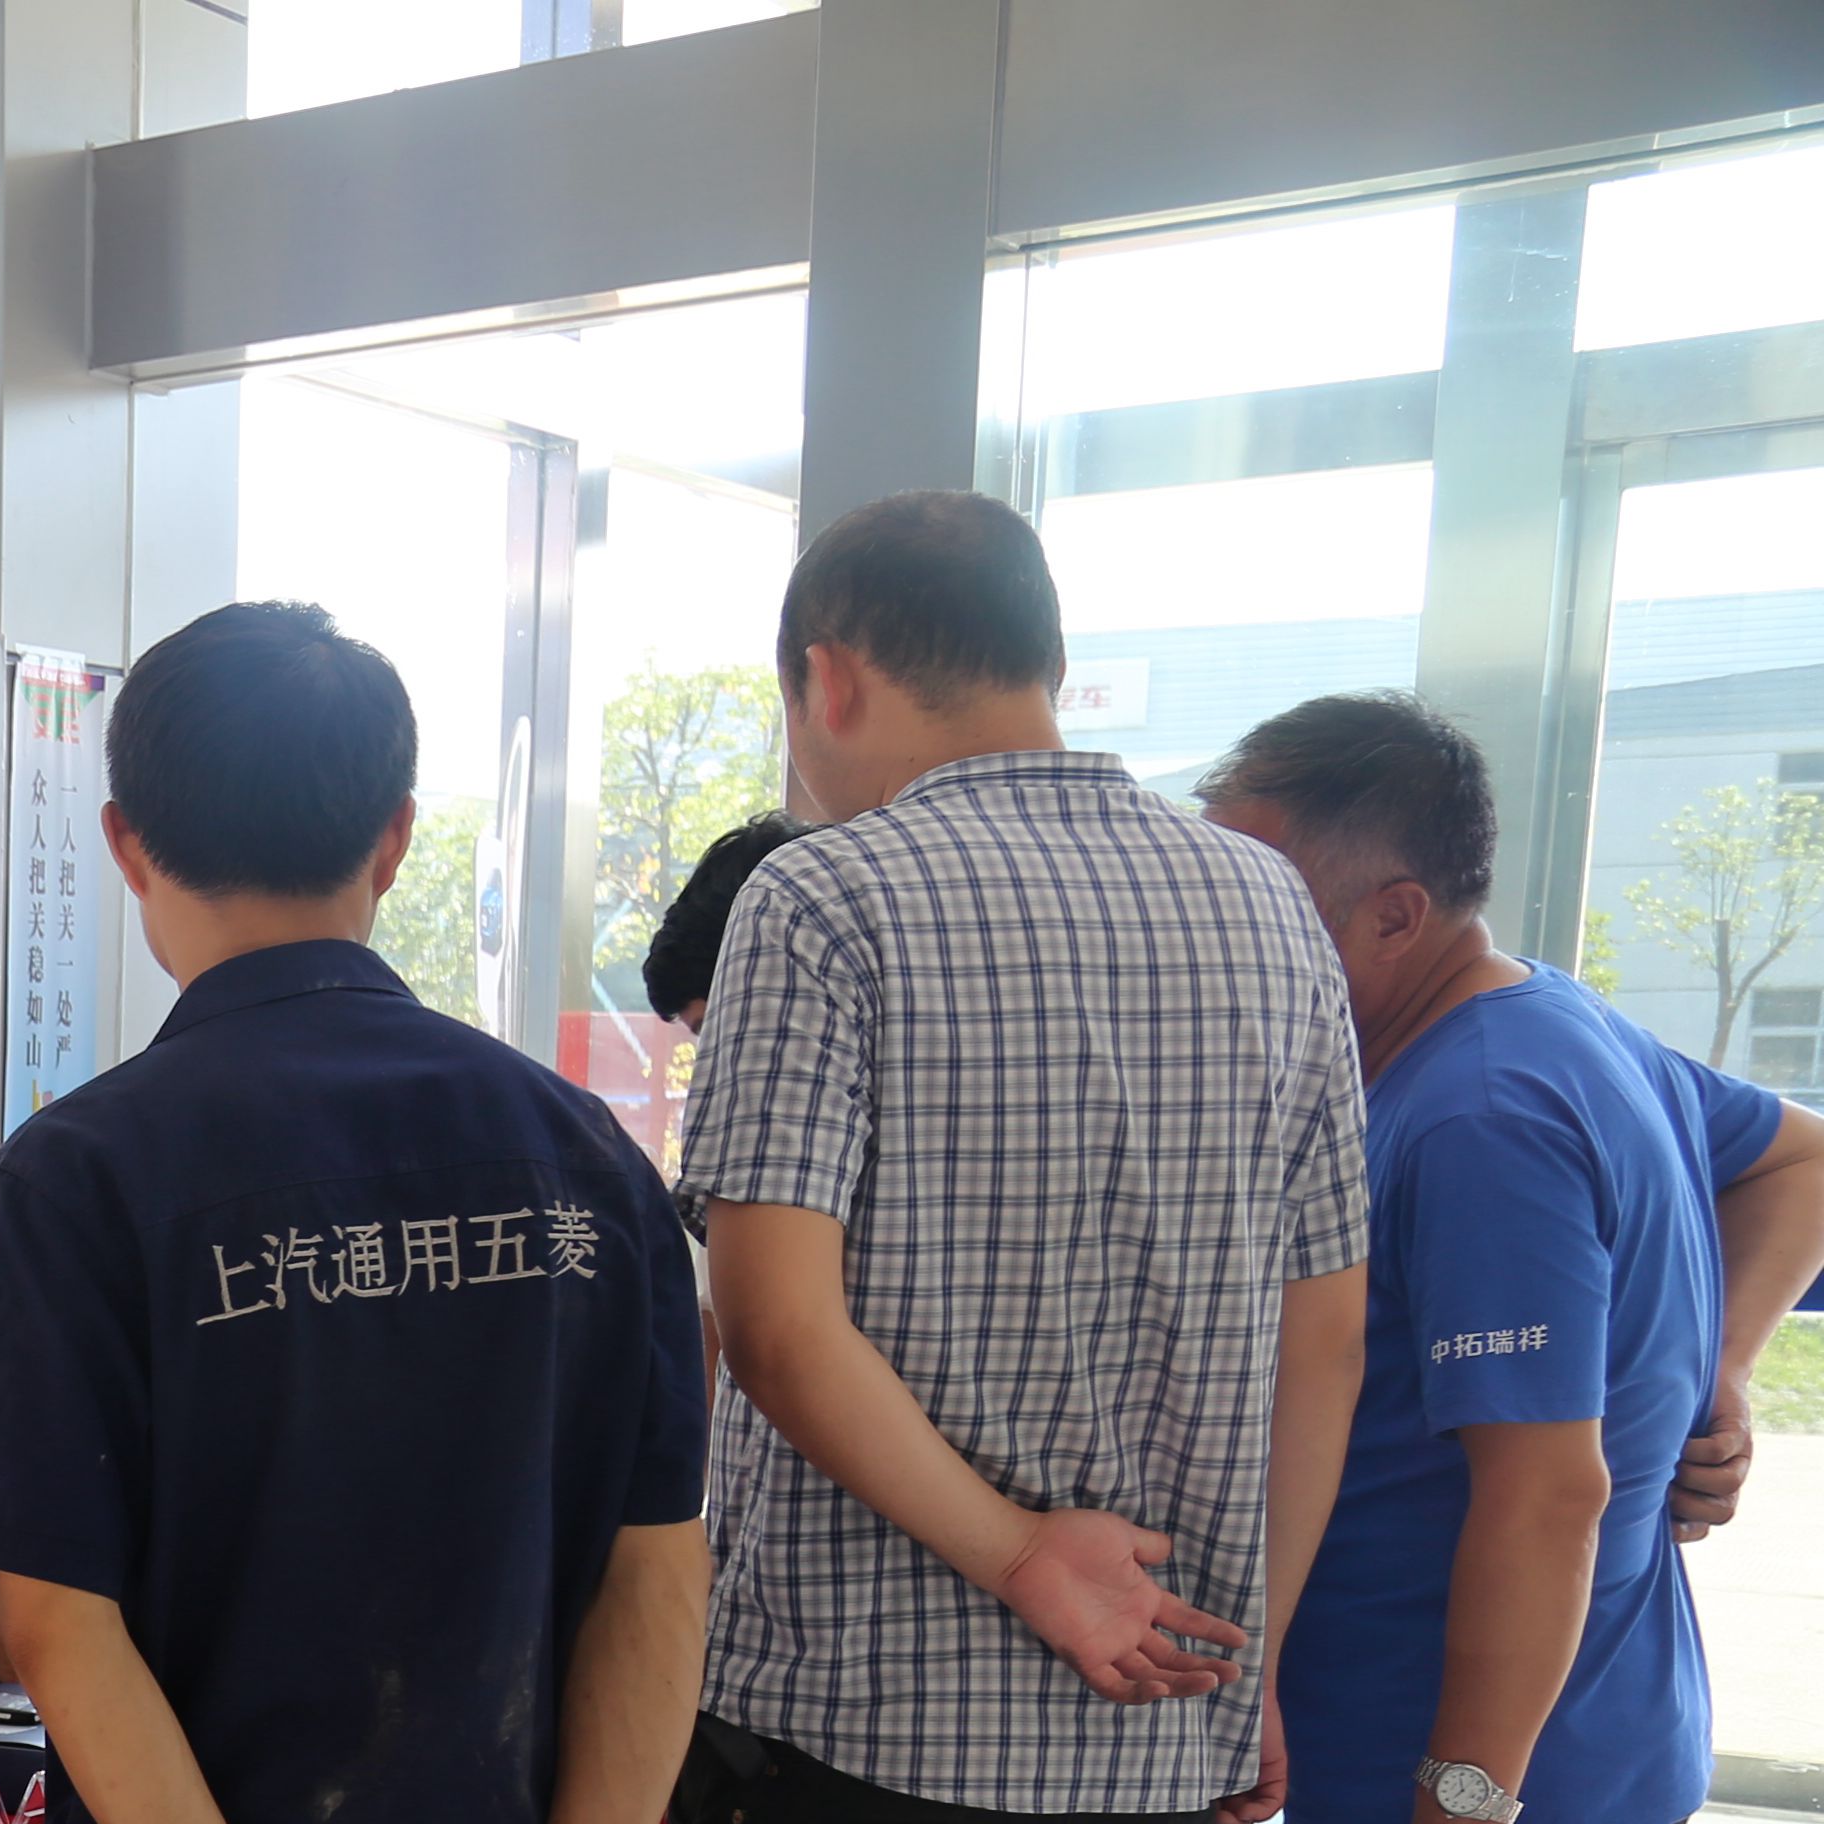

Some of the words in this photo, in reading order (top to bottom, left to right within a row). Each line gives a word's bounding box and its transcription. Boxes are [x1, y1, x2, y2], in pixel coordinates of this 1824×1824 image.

[25, 768, 48, 1069] 众人把关稳如山
[195, 1200, 600, 1326] 上汽通用五菱
[1431, 1324, 1549, 1364] 中拓瑞祥
